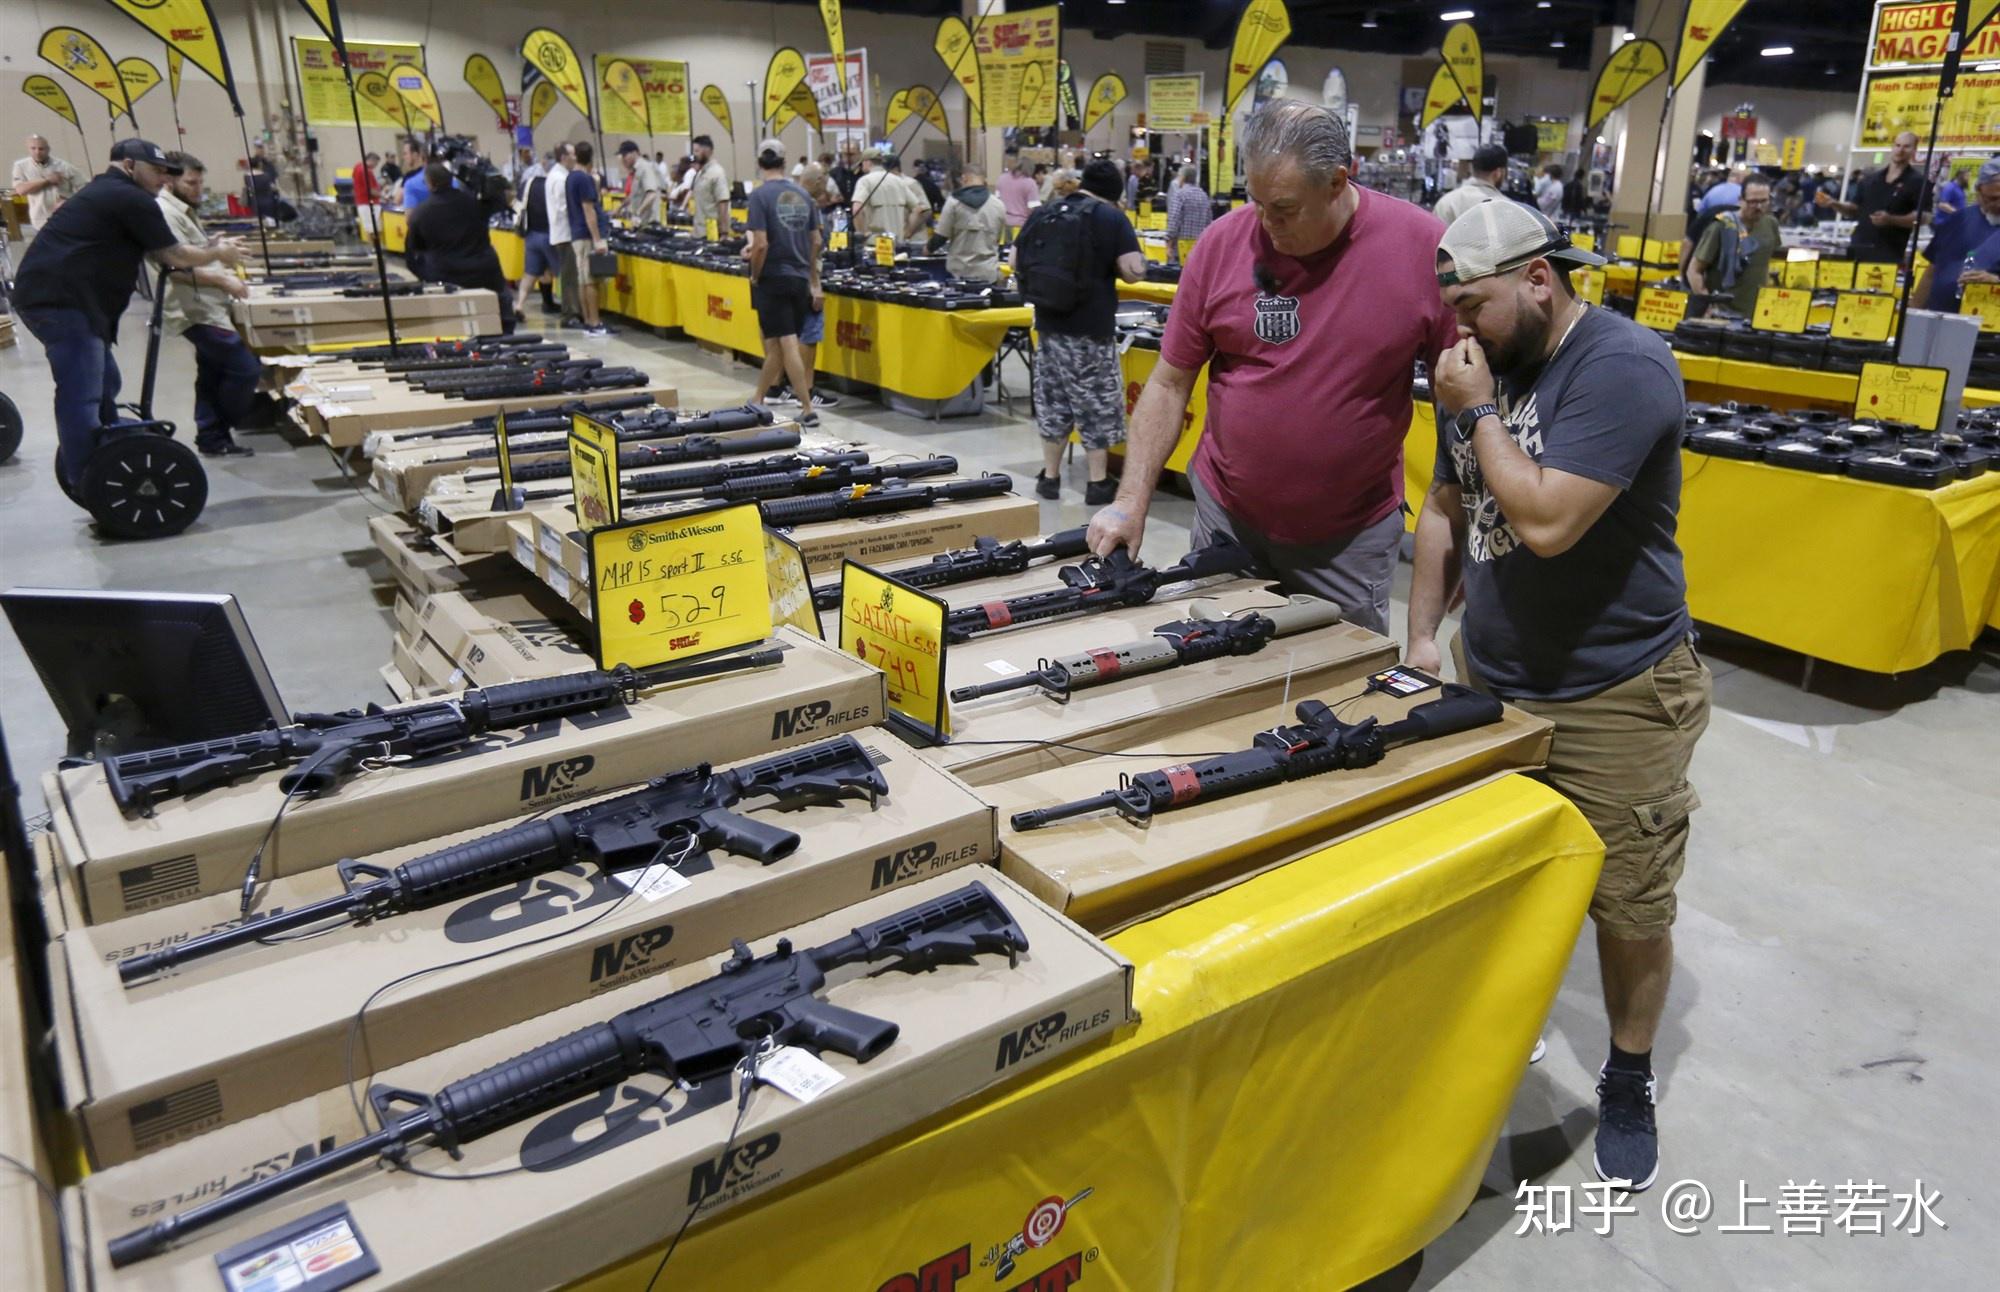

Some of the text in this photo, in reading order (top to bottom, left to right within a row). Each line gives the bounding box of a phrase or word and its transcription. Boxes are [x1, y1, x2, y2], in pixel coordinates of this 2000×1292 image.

[1881, 8, 1937, 31] HIGH
[639, 559, 652, 581] 15
[721, 550, 743, 566] 5.56
[661, 585, 726, 629] 529
[851, 598, 912, 644] SAINT
[869, 643, 920, 696] 749
[771, 700, 870, 741] M&P RIFLES
[520, 754, 595, 801] M&P
[870, 841, 979, 891] M&P RIFLES
[590, 925, 674, 983] M&P
[995, 1008, 1110, 1072] M&P RIFLES
[688, 1131, 781, 1206] M&P
